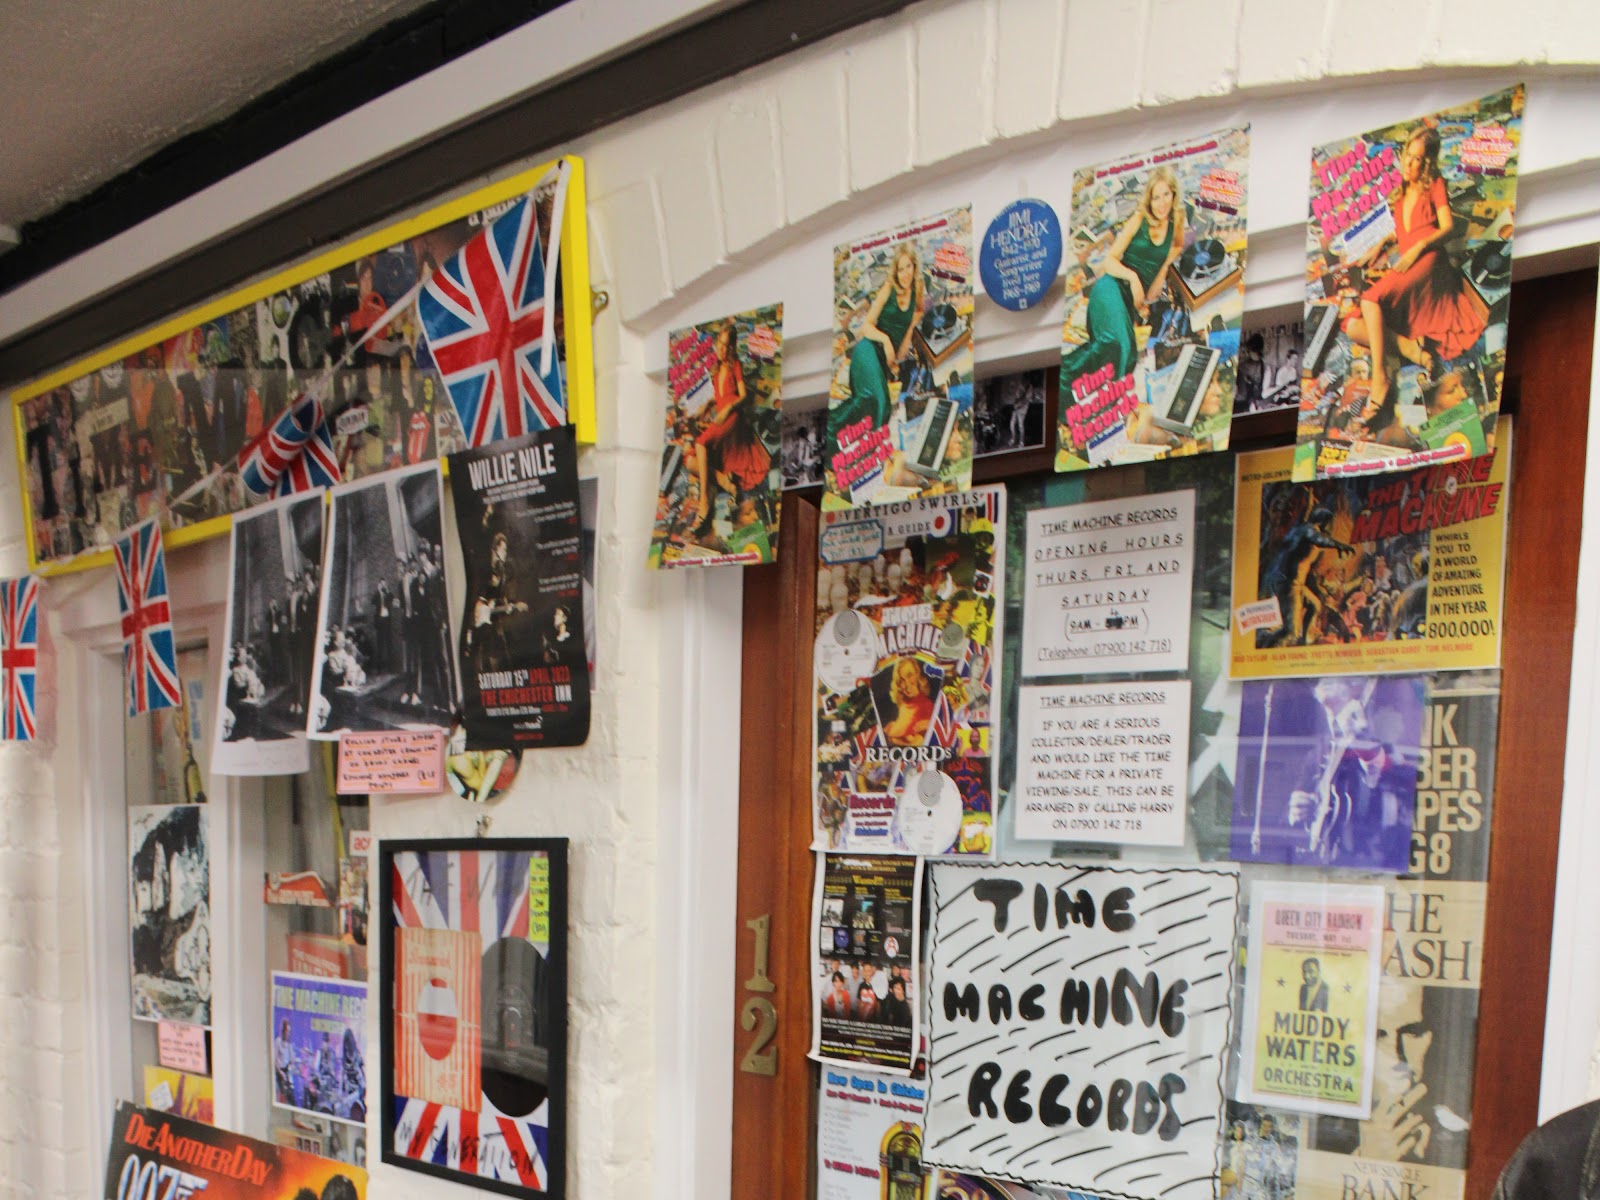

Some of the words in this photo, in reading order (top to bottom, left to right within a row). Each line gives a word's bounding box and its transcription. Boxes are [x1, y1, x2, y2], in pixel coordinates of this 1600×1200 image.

[1317, 141, 1367, 188] Time
[1311, 146, 1395, 219] Machine
[1321, 167, 1403, 241] Records
[990, 219, 1049, 249] HENDRIX
[1072, 362, 1115, 401] Time
[1065, 372, 1136, 427] Machine
[836, 414, 873, 449] Time
[1072, 393, 1139, 448] Records
[831, 423, 891, 473] Machine
[468, 451, 518, 491] WILLIE
[518, 443, 557, 480] NILE
[1041, 519, 1069, 534] TIME
[1072, 512, 1124, 530] MACHINE
[1127, 507, 1179, 524] RECORDS
[1351, 481, 1504, 545] MACHINE
[899, 522, 932, 535] GUIDE
[1435, 531, 1469, 543] WHIRLS
[1035, 541, 1108, 561] OPENING
[1125, 533, 1184, 551] HOURS
[1435, 543, 1454, 555] YOU
[1458, 543, 1471, 553] TO
[1146, 559, 1181, 572] AND
[1433, 571, 1443, 581] OF
[1442, 568, 1482, 581] AMAZING
[1434, 558, 1442, 568] A
[1444, 555, 1478, 567] WORLD
[1061, 588, 1150, 608] SATURDAY
[1432, 584, 1484, 599] ADVENTURE
[1430, 604, 1441, 616] IN
[1442, 602, 1460, 616] THE
[1461, 600, 1488, 614] YEAR
[1428, 619, 1496, 640] 800,000!
[477, 670, 513, 690] SATURDAY
[500, 685, 553, 706] CHICHESTER
[555, 684, 572, 702] INN
[1040, 696, 1066, 707] TIME
[1069, 693, 1117, 706] MACHINE
[1119, 691, 1166, 704] RECORDS
[1042, 721, 1053, 731] IF
[1057, 720, 1077, 731] YOU
[1081, 719, 1100, 730] ARE
[1103, 719, 1110, 729] A
[1114, 717, 1160, 730] SERIOUS
[865, 745, 953, 764] RECORDS
[1031, 733, 1172, 749] COLLECTOR/DEALER/TRADER
[1030, 753, 1051, 765] AND
[1055, 752, 1090, 764] WOULD
[1093, 751, 1115, 763] LIKE
[1120, 751, 1140, 763] THE
[1145, 750, 1172, 762] TIME
[1037, 769, 1081, 781] MACHINE
[1085, 769, 1105, 780] FOR
[1109, 769, 1116, 779] A
[1119, 767, 1163, 780] PRIVATE
[1107, 785, 1132, 797] THIS
[1136, 785, 1157, 797] CAN
[1161, 785, 1174, 797] BE
[1025, 802, 1074, 814] ARRANGED
[1078, 802, 1090, 814] BY
[1094, 802, 1136, 814] CALLING
[1139, 802, 1174, 814] HARRY
[1052, 819, 1067, 830] ON
[1071, 818, 1100, 830] 07900
[1103, 818, 1121, 830] 142
[972, 876, 1137, 934] TIME
[1385, 892, 1445, 934] HE
[1382, 938, 1473, 981] ASH
[942, 966, 1190, 1039] MACHINE
[1274, 1011, 1351, 1041] MUDDY
[1265, 1034, 1357, 1068] WATERS
[1263, 1066, 1354, 1093] ORCHESTRA
[966, 1060, 1188, 1142] RECORDS
[124, 1112, 151, 1146] DIE
[151, 1121, 233, 1179] ANOTHER
[231, 1143, 273, 1188] DAY
